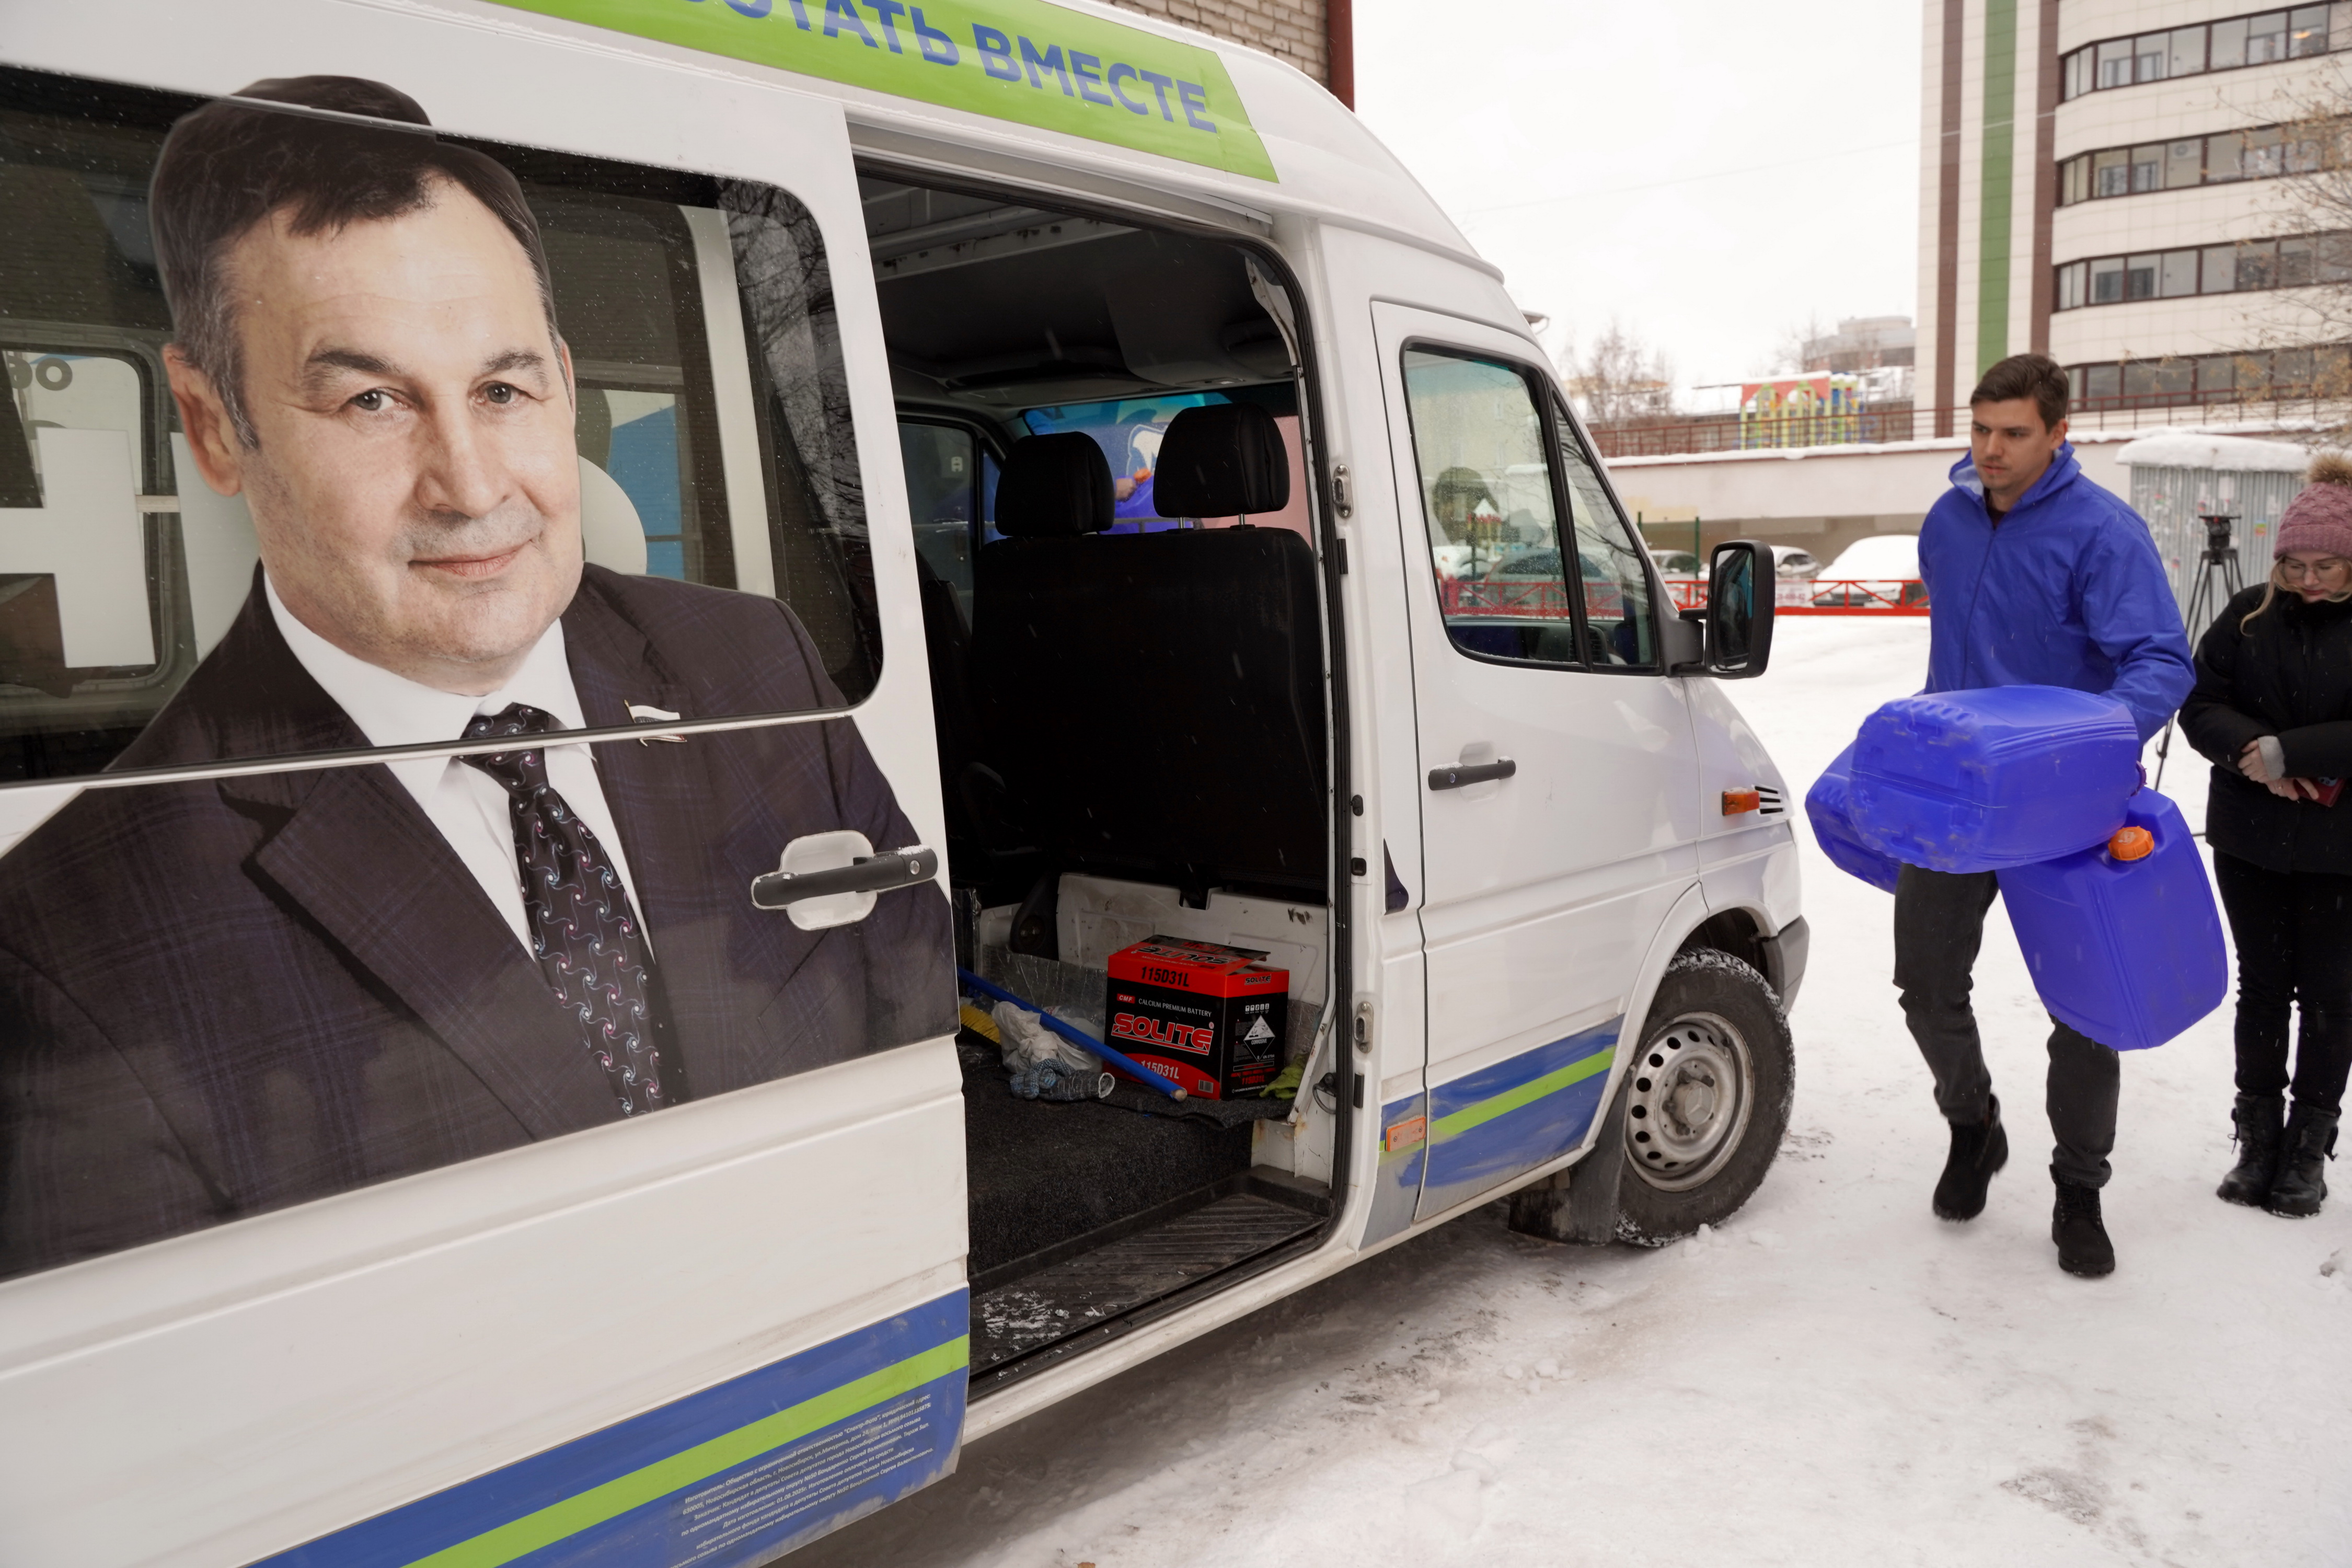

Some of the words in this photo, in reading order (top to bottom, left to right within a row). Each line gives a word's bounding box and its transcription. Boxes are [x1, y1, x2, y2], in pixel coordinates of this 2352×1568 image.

[684, 0, 960, 66] ТАТЬ
[972, 23, 1217, 133] ВМЕСТЕ
[1138, 998, 1161, 1008] CALCIUM
[1162, 1002, 1186, 1013] PREMIUM
[1187, 1007, 1212, 1018] BATTERY
[1142, 966, 1190, 987] 115D31L
[1245, 975, 1271, 984] SOLITE
[1112, 1012, 1214, 1052] SOLITE
[1141, 1059, 1180, 1079] 115D31L
[683, 1502, 704, 1515] 630005,
[706, 1483, 748, 1504] Новосибирская
[750, 1474, 772, 1485] область,
[778, 1455, 813, 1473] Новосибирск,
[850, 1434, 861, 1443] дом
[889, 1416, 899, 1425] ИНН
[685, 1483, 724, 1503] Изготовитель:
[726, 1471, 753, 1485] Общество
[758, 1451, 796, 1471] ограниченной
[798, 1432, 843, 1455] ответственностью
[882, 1400, 915, 1417] юридический
[916, 1394, 930, 1403] адрес:
[690, 1507, 739, 1532] одномандатному
[741, 1487, 785, 1509] избирательному
[786, 1479, 803, 1489] округу
[804, 1472, 817, 1481] №50
[818, 1459, 848, 1475] Бондаренко
[849, 1449, 866, 1461] Сергей
[904, 1427, 918, 1436] Тираж
[694, 1505, 721, 1520] Заказчик:
[723, 1493, 749, 1507] Кандидат
[755, 1480, 780, 1494] депутаты
[781, 1471, 799, 1481] Совета
[800, 1459, 825, 1474] депутатов
[827, 1451, 844, 1461] города
[845, 1435, 880, 1453] Новосибирска
[881, 1425, 903, 1437] восьмого
[904, 1417, 920, 1427] созыва
[723, 1518, 736, 1529] Дата
[737, 1501, 775, 1520] изготовления:
[809, 1471, 843, 1489] Изготовление
[844, 1459, 868, 1473] оплачено
[875, 1448, 893, 1459] средств
[696, 1526, 741, 1549] избирательного
[742, 1518, 759, 1529] фонда
[761, 1504, 789, 1520] кандидата
[794, 1491, 818, 1506] депутаты
[819, 1483, 836, 1493] Совета
[837, 1471, 862, 1486] депутатов
[863, 1463, 880, 1473] города
[881, 1447, 914, 1465] Новосибирска
[697, 1547, 717, 1558] созыва
[727, 1520, 774, 1544] одномандатному
[775, 1501, 818, 1523] избирательному
[819, 1492, 836, 1502] округу
[837, 1485, 849, 1494] №50
[850, 1472, 879, 1488] Бондаренко
[880, 1465, 896, 1474] Сергея
